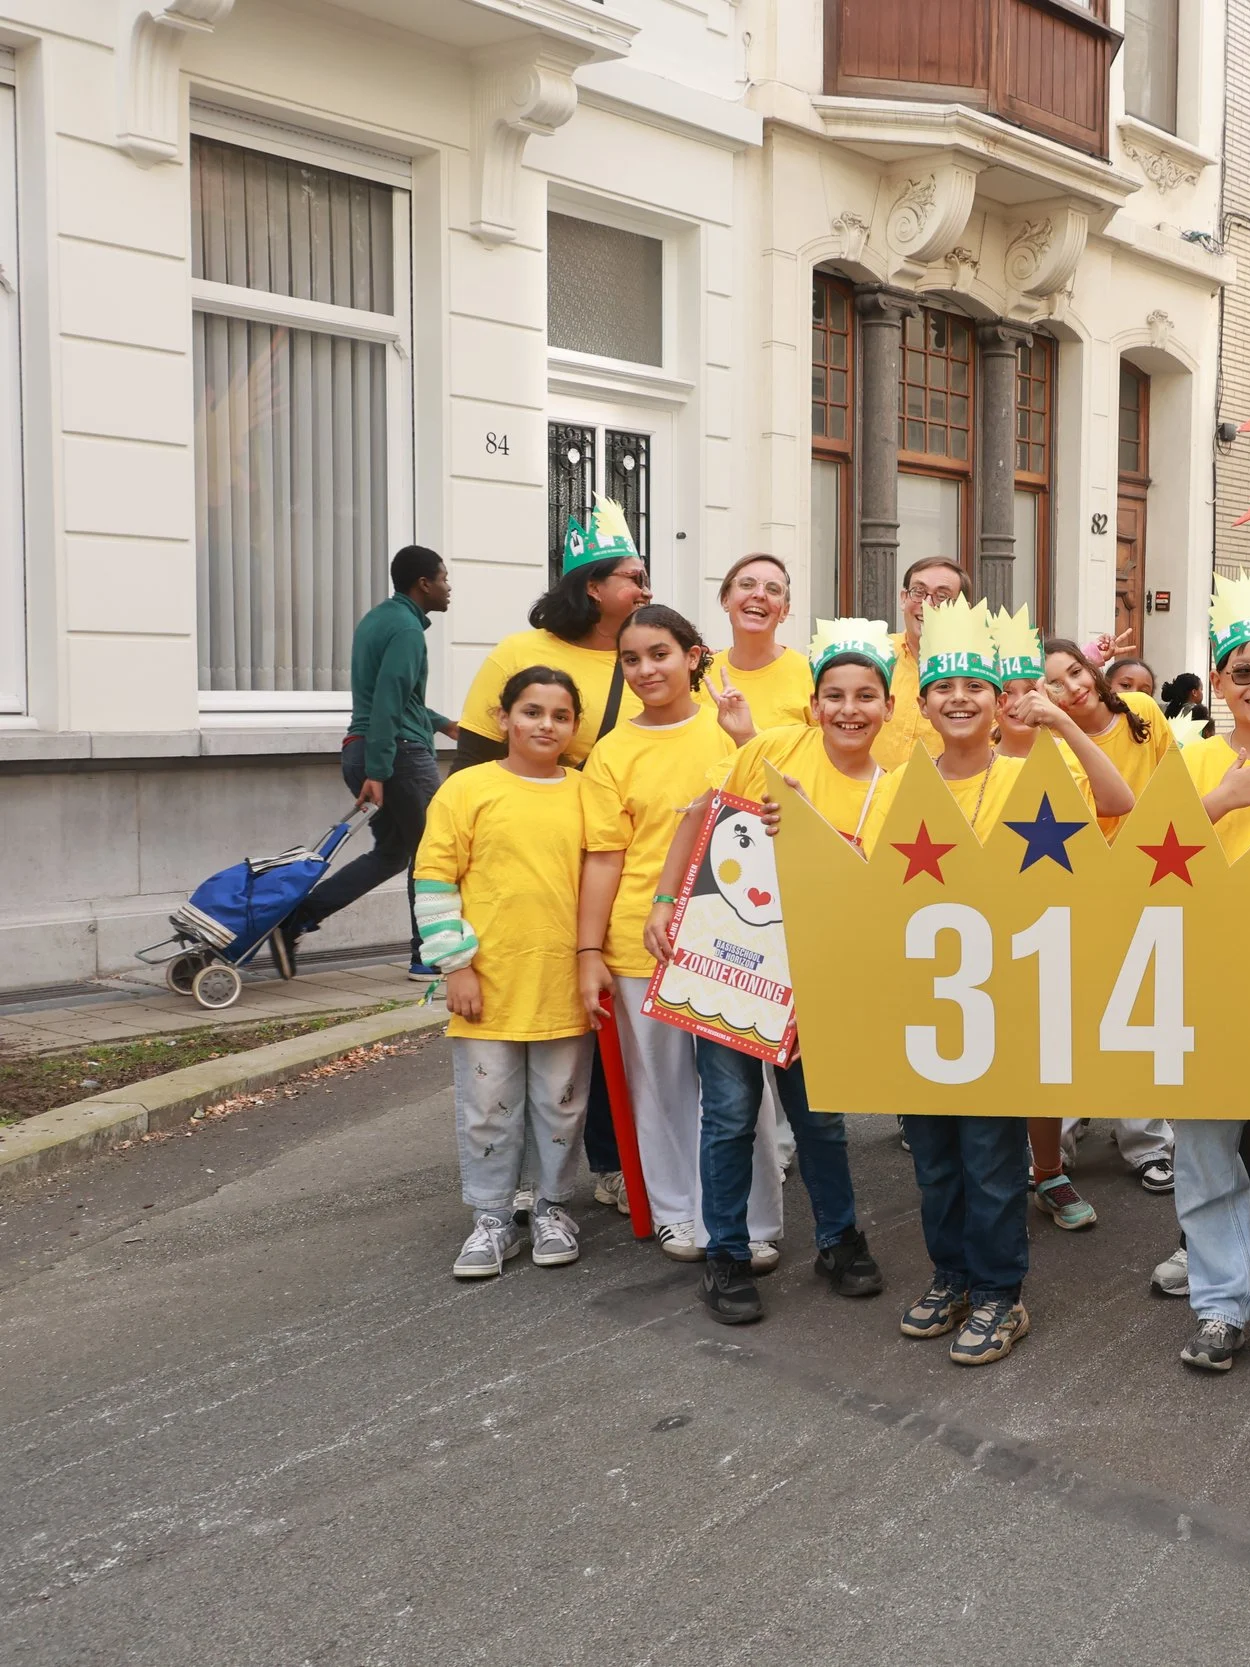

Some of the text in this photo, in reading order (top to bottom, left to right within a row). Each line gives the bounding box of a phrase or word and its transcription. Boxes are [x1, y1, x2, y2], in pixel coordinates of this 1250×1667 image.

[485, 431, 510, 456] 84
[1091, 512, 1108, 535] 82
[937, 652, 969, 673] 314
[668, 863, 699, 940] LANG ZULLEN ZE LEVEN
[714, 949, 756, 970] DE HORIZON
[715, 940, 761, 963] BASISSCHOOL
[679, 950, 786, 1004] ZONNEKONING
[905, 902, 1195, 1086] 314
